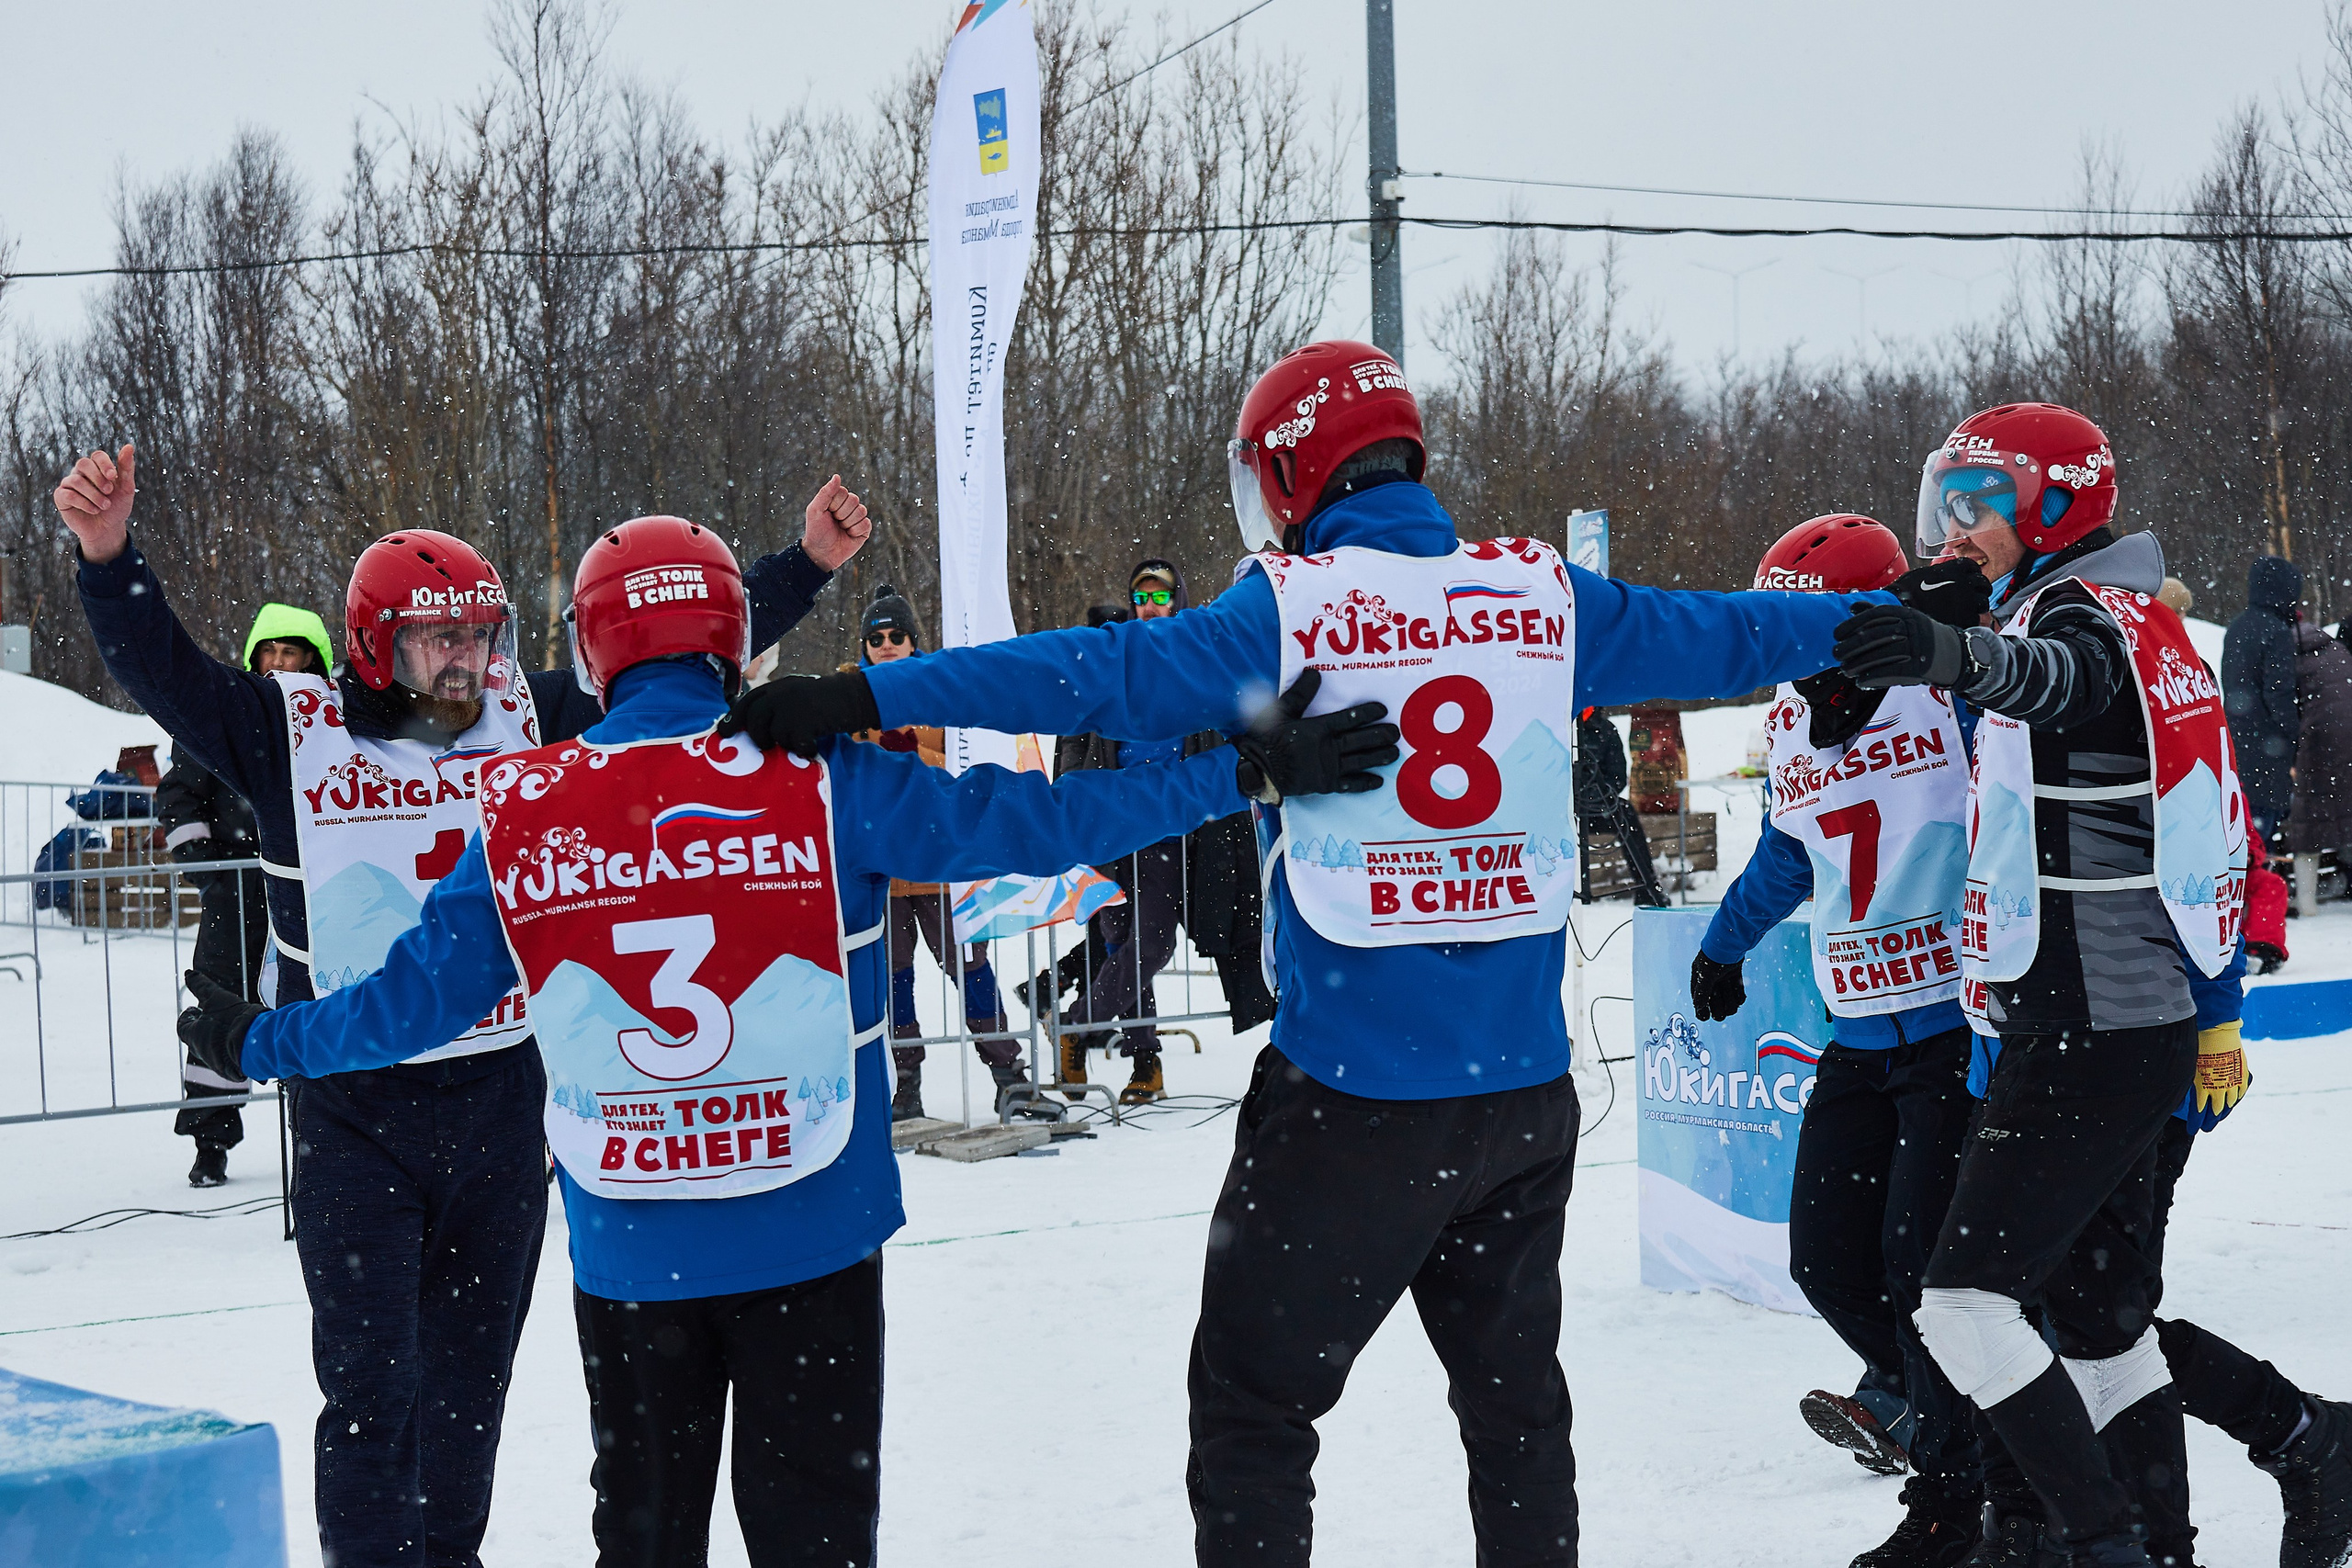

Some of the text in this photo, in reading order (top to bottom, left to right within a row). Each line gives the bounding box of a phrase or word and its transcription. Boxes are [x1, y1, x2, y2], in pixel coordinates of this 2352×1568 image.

[1358, 378, 1373, 393] В
[1973, 457, 2005, 466] РОССИИ
[659, 570, 705, 583] ТОЛК
[628, 583, 708, 609] В СНЕГЕ
[399, 609, 441, 617] МУРМАНСК
[1342, 660, 1396, 671] MURMANSK
[1398, 657, 1432, 668] REGION
[1516, 650, 1554, 661] СНЕЖНЫЙ
[1396, 674, 1502, 829] 8
[1891, 759, 1949, 779] СНЕЖНЫЙ БОЙ
[347, 814, 394, 823] MURMANSK
[1367, 843, 1524, 873] ДЛЯ ТЕХ, ТОЛК
[1815, 799, 1882, 923] 7
[1367, 866, 1442, 875] КТО ЗНАЕТ
[743, 878, 822, 891] СНЕЖНЫЙ БОЙ
[545, 899, 596, 915] MURMANSK
[597, 895, 637, 908] REGION
[1370, 875, 1535, 915] В СНЕГЕ
[1865, 920, 1949, 956] ТОЛК
[1840, 952, 1866, 963] ЗНАЕТ
[1832, 945, 1959, 994] В СНЕГЕ
[612, 914, 734, 1082] 3
[601, 1089, 791, 1127] ДЛЯ ТЕХ, ТОЛК
[605, 1120, 666, 1131] КТО ЗНАЕТ
[1645, 1110, 1773, 1134] РОССИЯ, МУРМАНСКАЯ ОБЛАСТЬ
[600, 1123, 792, 1172] В СНЕГЕ
